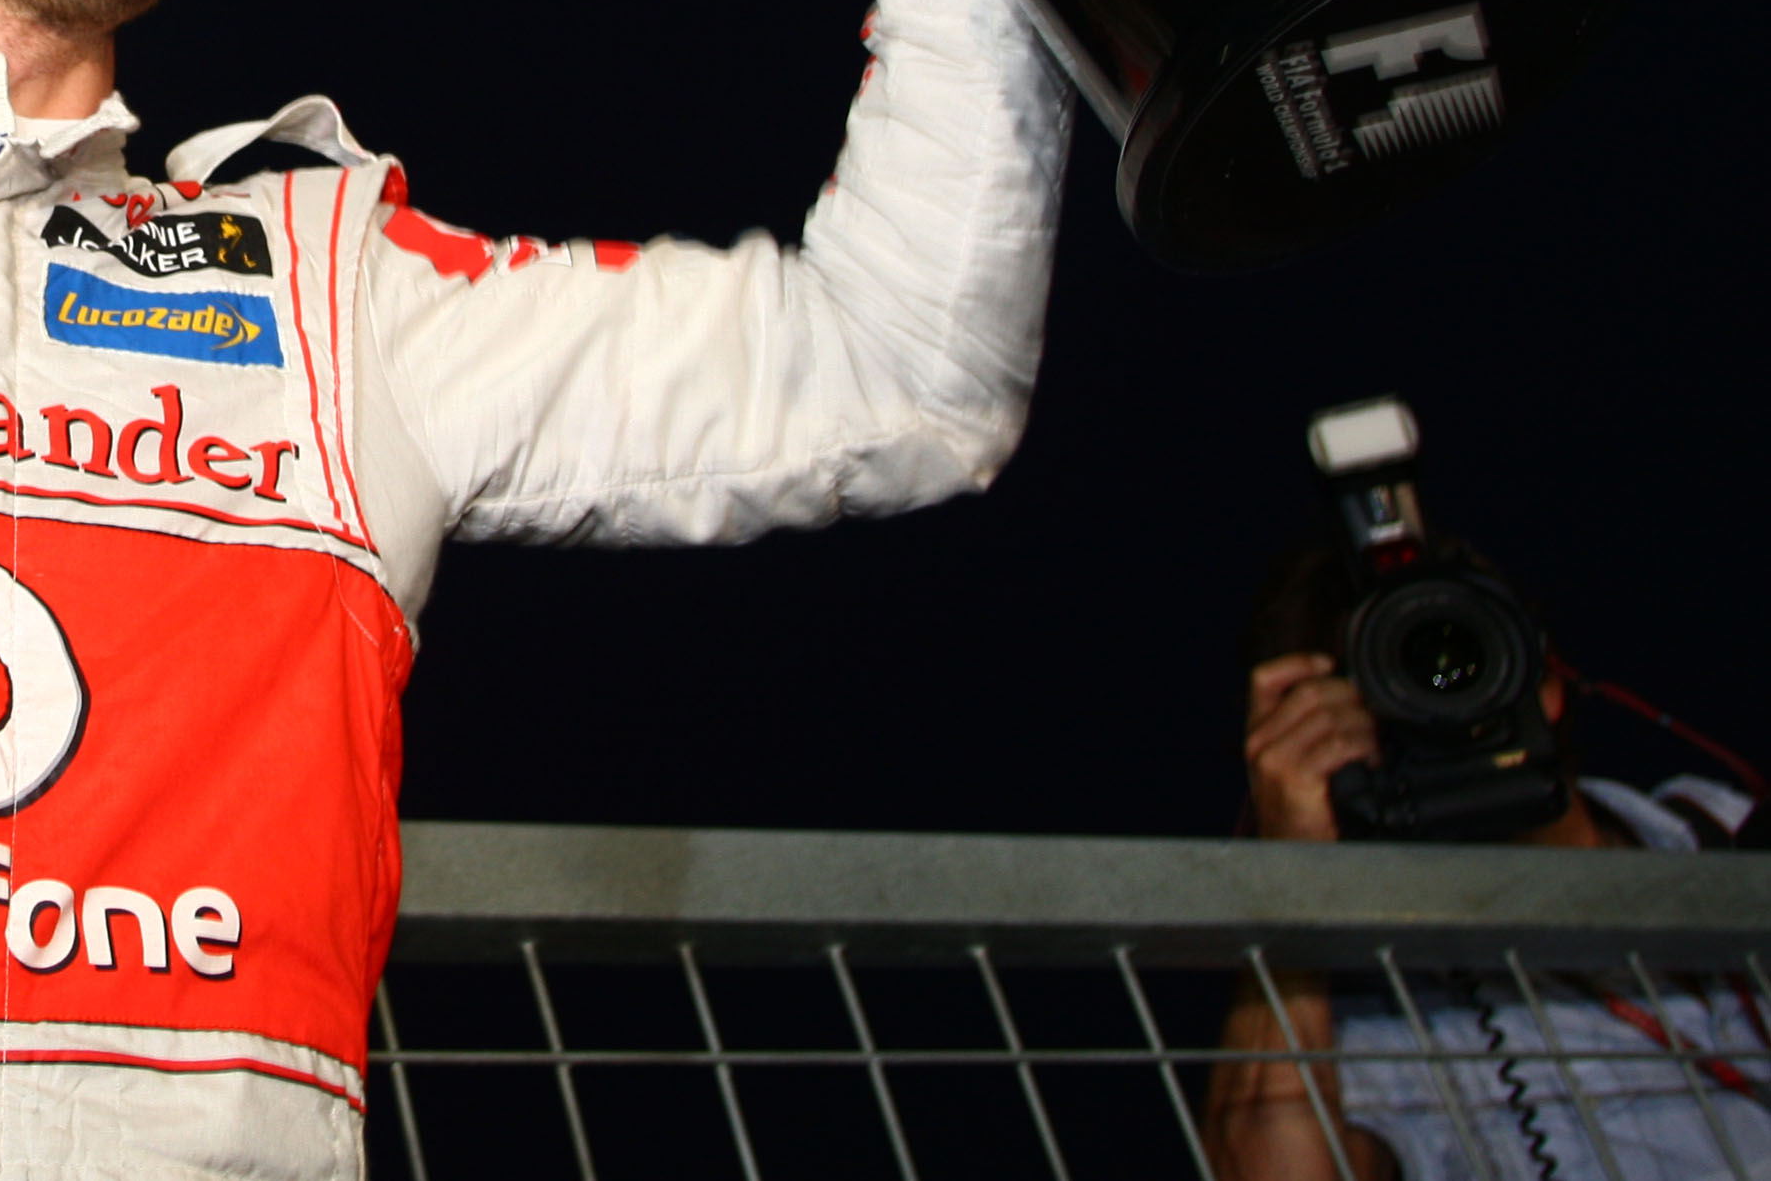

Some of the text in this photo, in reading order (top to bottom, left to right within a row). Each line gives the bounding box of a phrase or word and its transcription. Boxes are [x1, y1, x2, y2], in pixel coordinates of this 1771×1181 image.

[1256, 61, 1285, 104] WORLD
[1279, 52, 1316, 89] FIA
[1296, 89, 1342, 165] Formula
[58, 292, 235, 338] Lucozade
